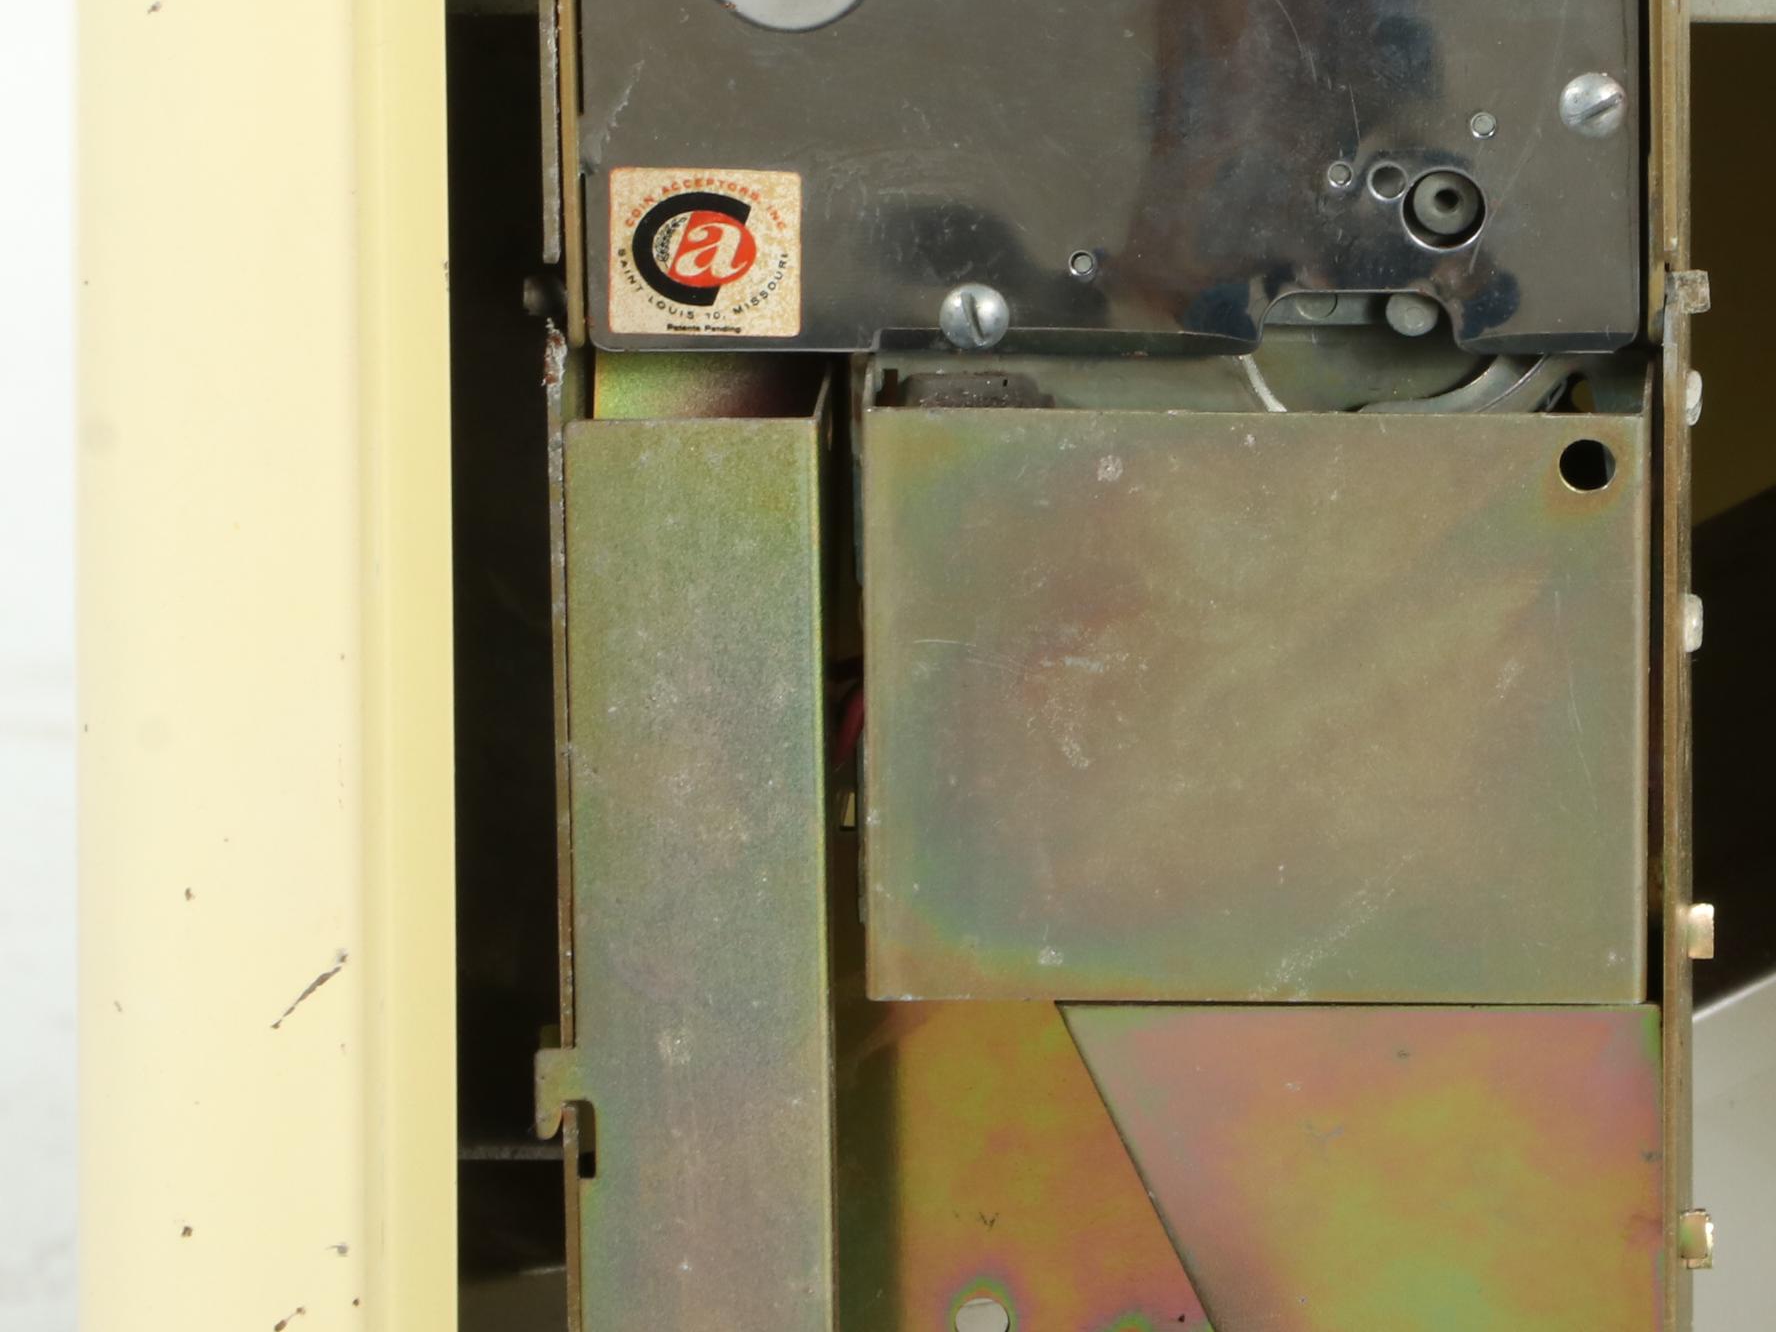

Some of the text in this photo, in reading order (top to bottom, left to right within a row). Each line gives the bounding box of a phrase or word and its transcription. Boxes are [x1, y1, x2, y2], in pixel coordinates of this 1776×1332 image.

[625, 194, 655, 228] COIN
[618, 248, 644, 293] SAINT
[648, 295, 695, 320] LOUIS
[733, 253, 788, 315] MISSOURI
